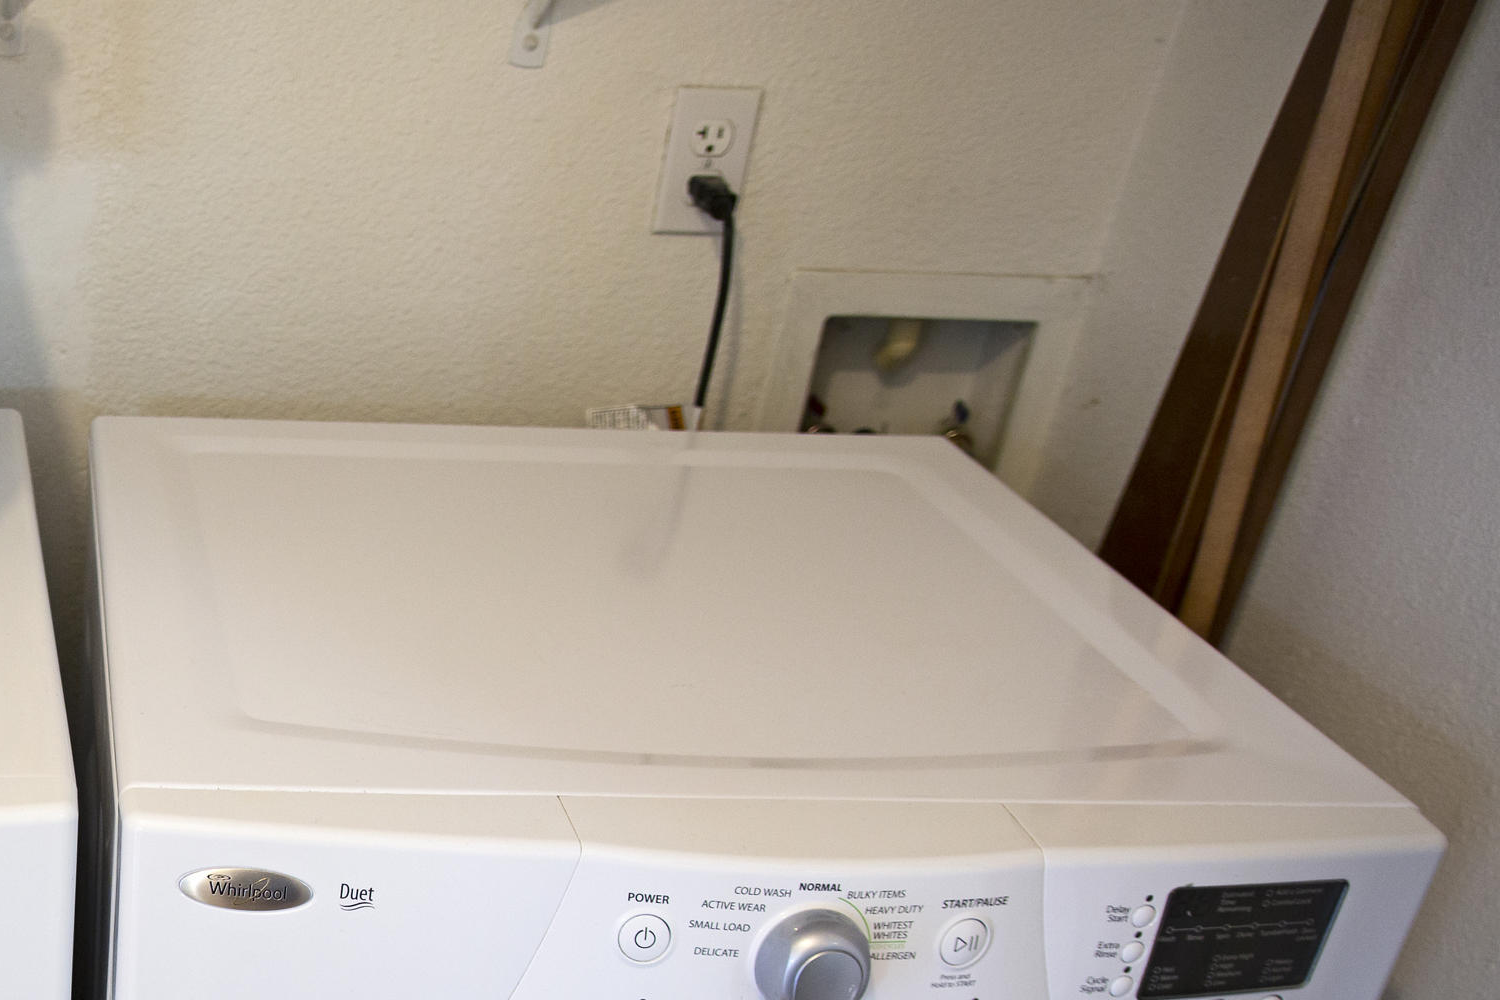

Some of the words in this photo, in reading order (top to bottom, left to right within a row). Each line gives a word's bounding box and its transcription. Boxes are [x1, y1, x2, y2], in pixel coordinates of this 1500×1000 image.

[209, 881, 287, 901] Whirlpool
[339, 883, 375, 901] Duet
[734, 886, 761, 896] COLD
[764, 888, 792, 898] WASH
[799, 882, 842, 892] NORMAL
[627, 892, 670, 904] POWER
[847, 891, 878, 900] BULKY
[878, 890, 907, 899] ITEMS
[701, 900, 736, 911] ACTIVE
[738, 902, 766, 912] WEAR
[941, 895, 1010, 909] START/PAUSE
[865, 906, 896, 915] HEAVY
[897, 904, 924, 914] DUTY
[689, 919, 720, 930] SMALL
[723, 922, 751, 932] LOAD
[873, 921, 914, 930] WHITEST
[873, 931, 908, 940] WHITES
[694, 946, 739, 958] DELICATE
[869, 951, 917, 961] ALLERGEN
